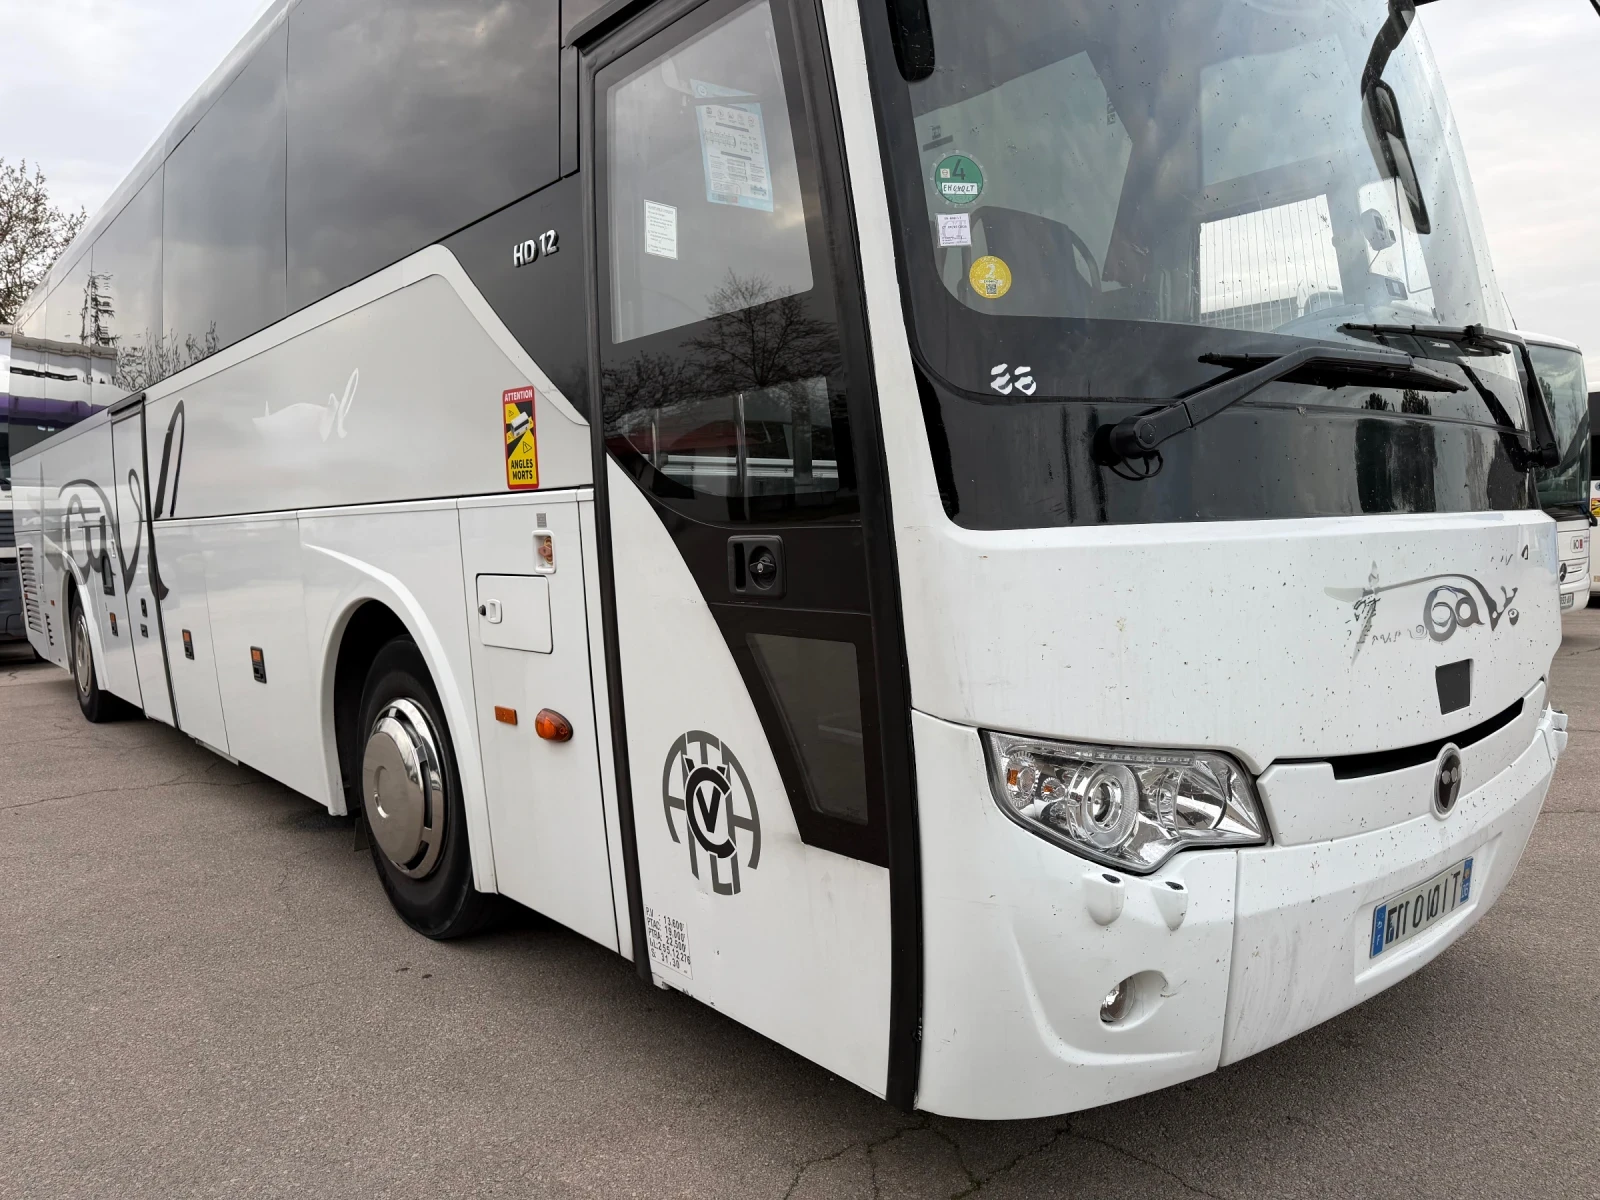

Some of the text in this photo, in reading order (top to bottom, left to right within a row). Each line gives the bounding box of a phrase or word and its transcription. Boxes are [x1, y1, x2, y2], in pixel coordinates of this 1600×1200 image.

[952, 159, 966, 180] 4
[513, 229, 559, 268] HD 12
[504, 389, 533, 402] ATTENTION
[511, 459, 534, 470] ANGLES
[512, 470, 534, 481] MORTS
